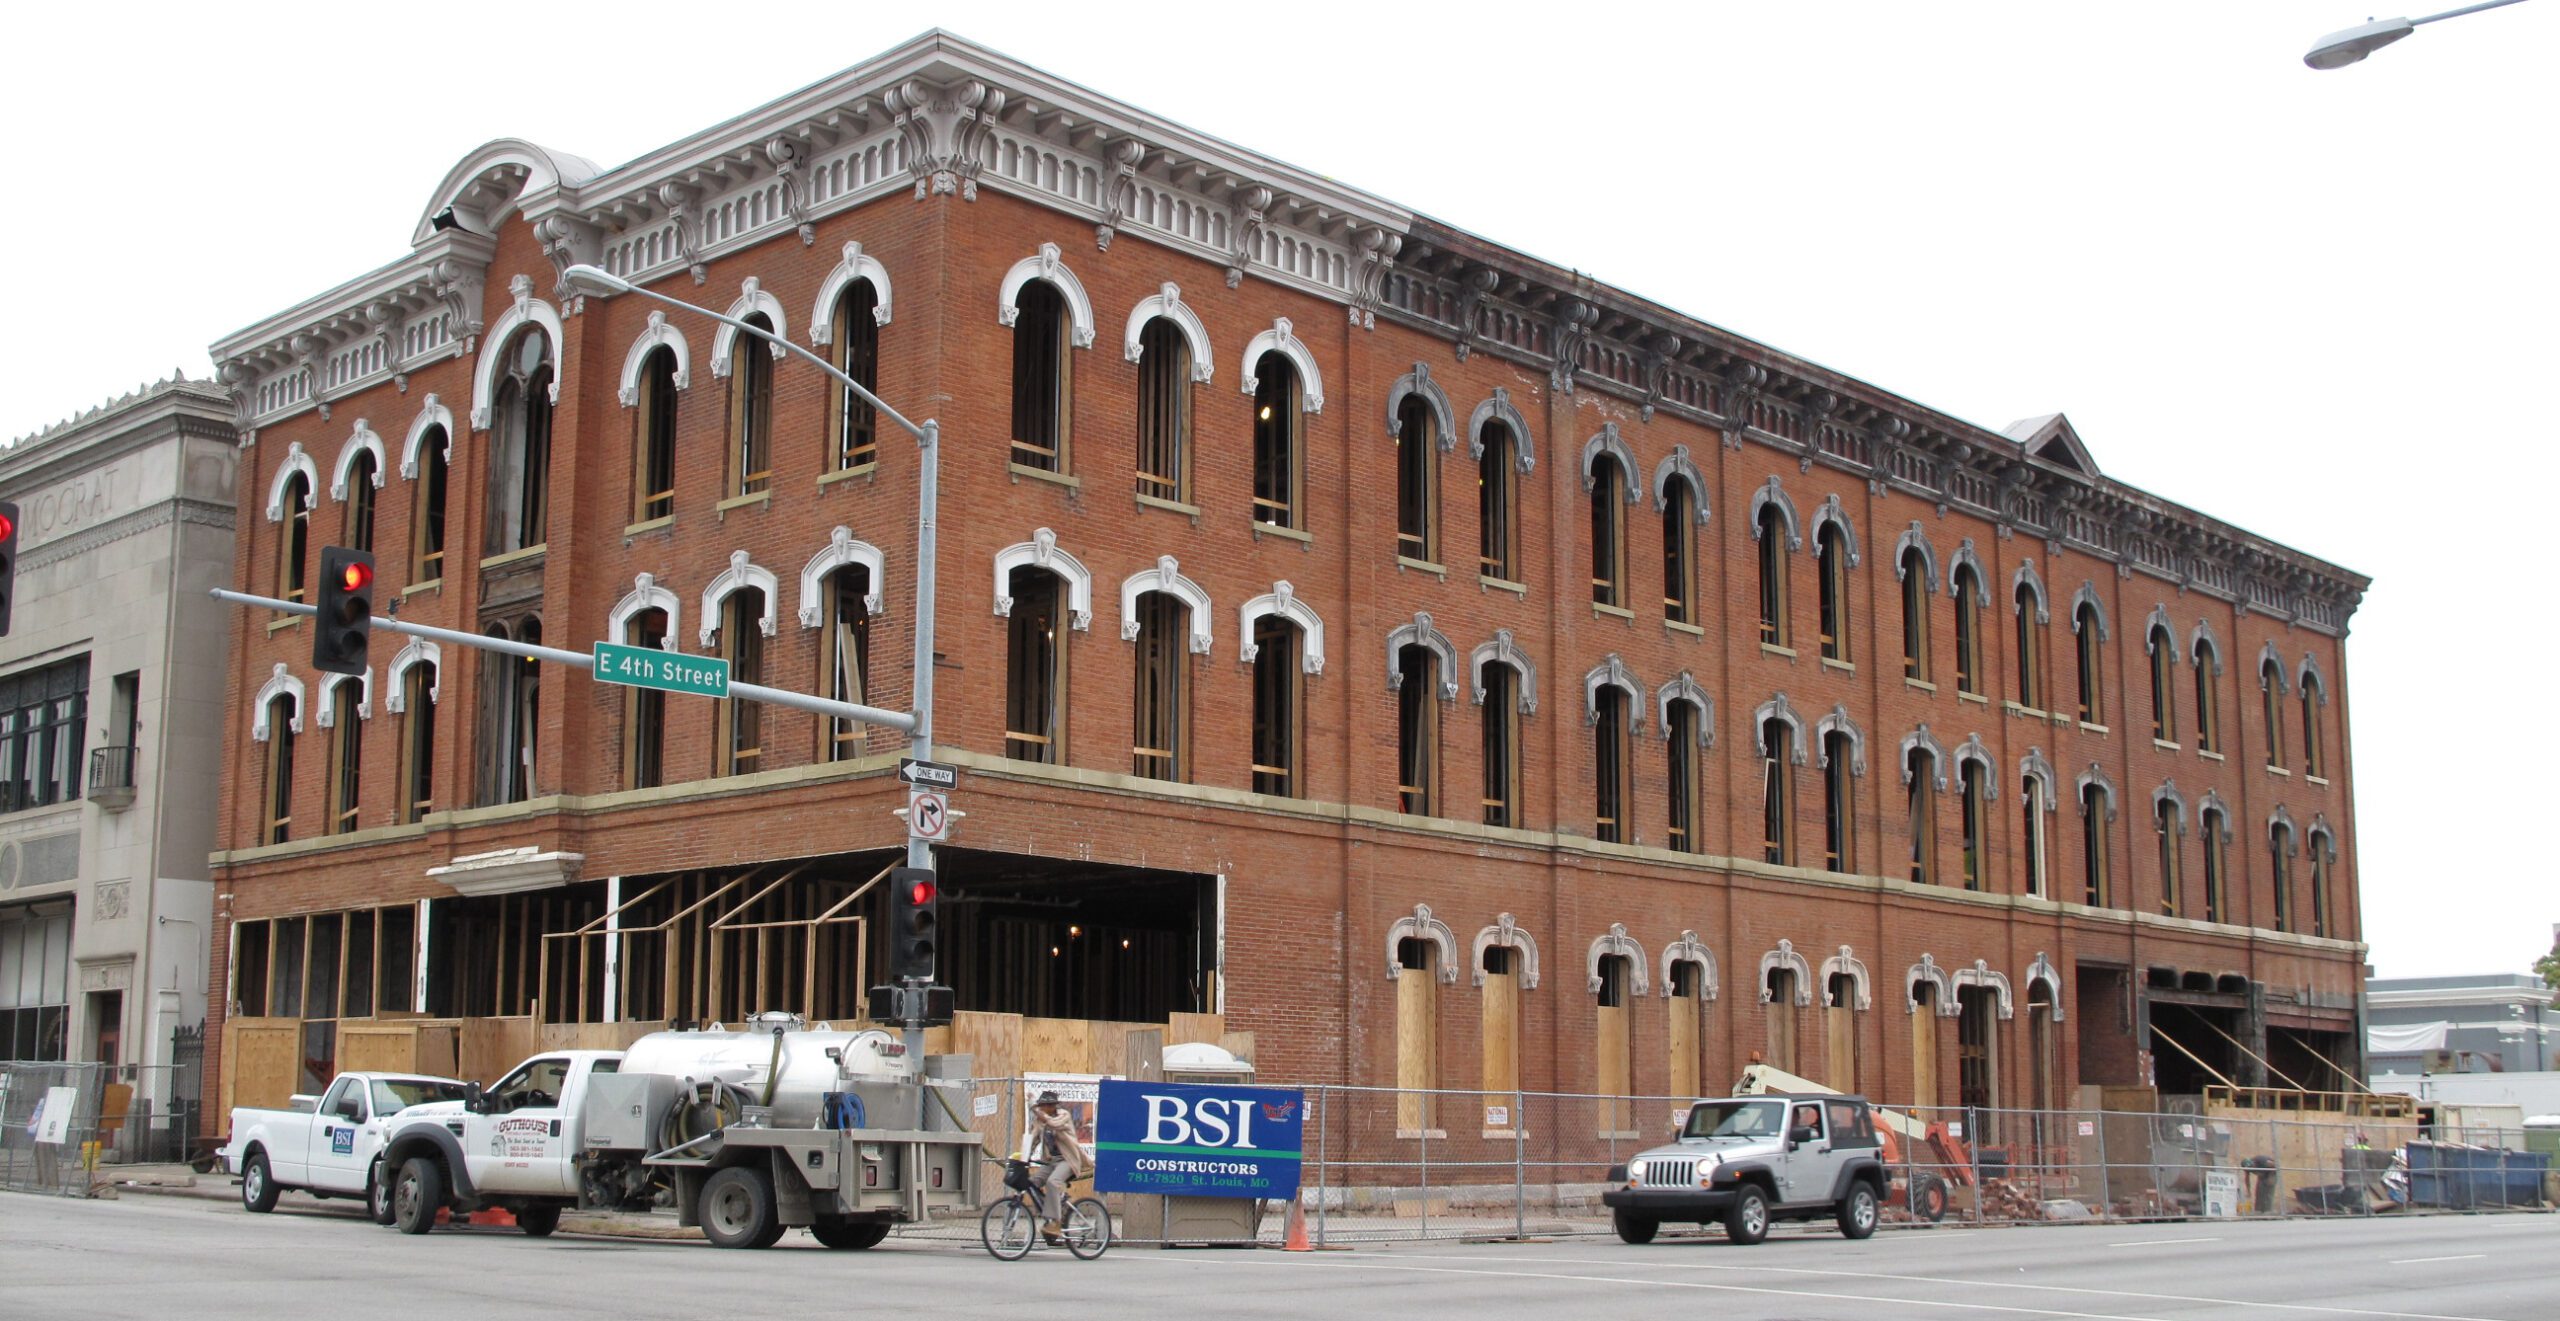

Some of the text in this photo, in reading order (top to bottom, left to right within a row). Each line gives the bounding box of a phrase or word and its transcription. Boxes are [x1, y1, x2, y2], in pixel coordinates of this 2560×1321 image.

[20, 468, 119, 542] MOCRAT
[600, 652, 722, 687] E 4th Street
[916, 767, 951, 781] ONE WAY
[499, 1119, 548, 1134] OUTHOUSE
[1140, 1094, 1258, 1149] BSI
[335, 1131, 352, 1146] BSI
[1136, 1159, 1258, 1175] CONSTRUCTORS
[1127, 1172, 1270, 1188] 781-7820 St. Louis, MO
